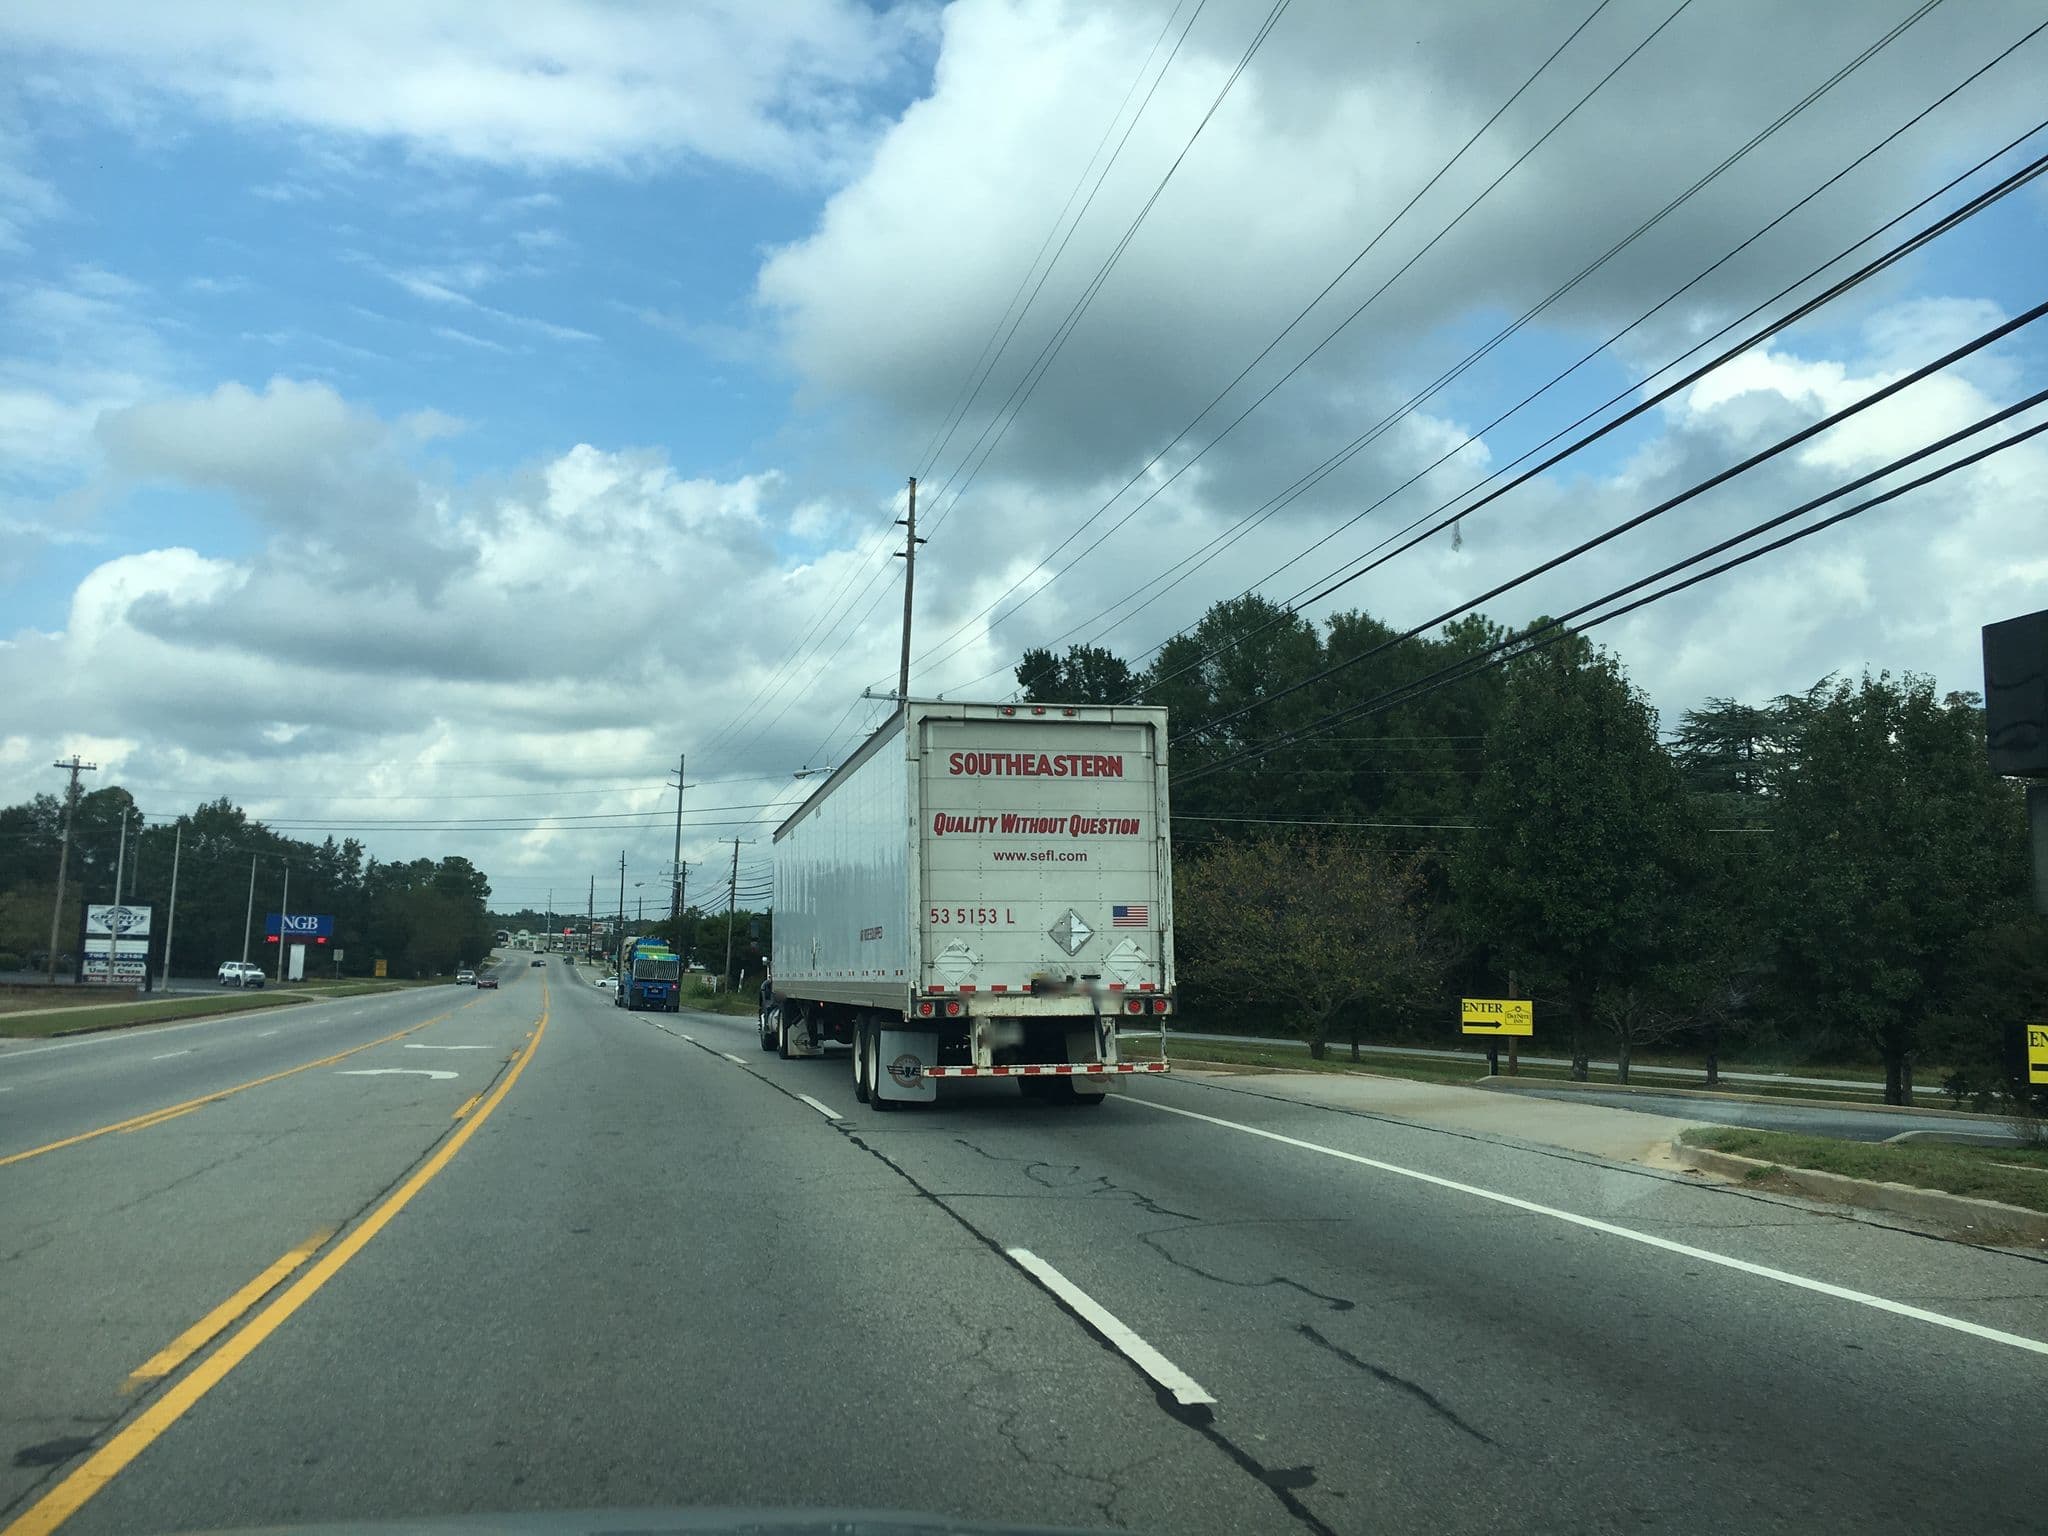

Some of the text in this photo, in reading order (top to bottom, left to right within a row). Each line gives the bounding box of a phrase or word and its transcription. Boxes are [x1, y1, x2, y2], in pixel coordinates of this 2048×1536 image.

[949, 752, 1123, 778] SOUTHEASTERN
[933, 812, 1141, 838] QUALITY WITHOUT QUESTION
[993, 850, 1088, 862] www.sefl.com
[281, 915, 318, 930] NGB
[930, 908, 1016, 925] 53 5153 L
[1463, 1002, 1503, 1013] ENTER
